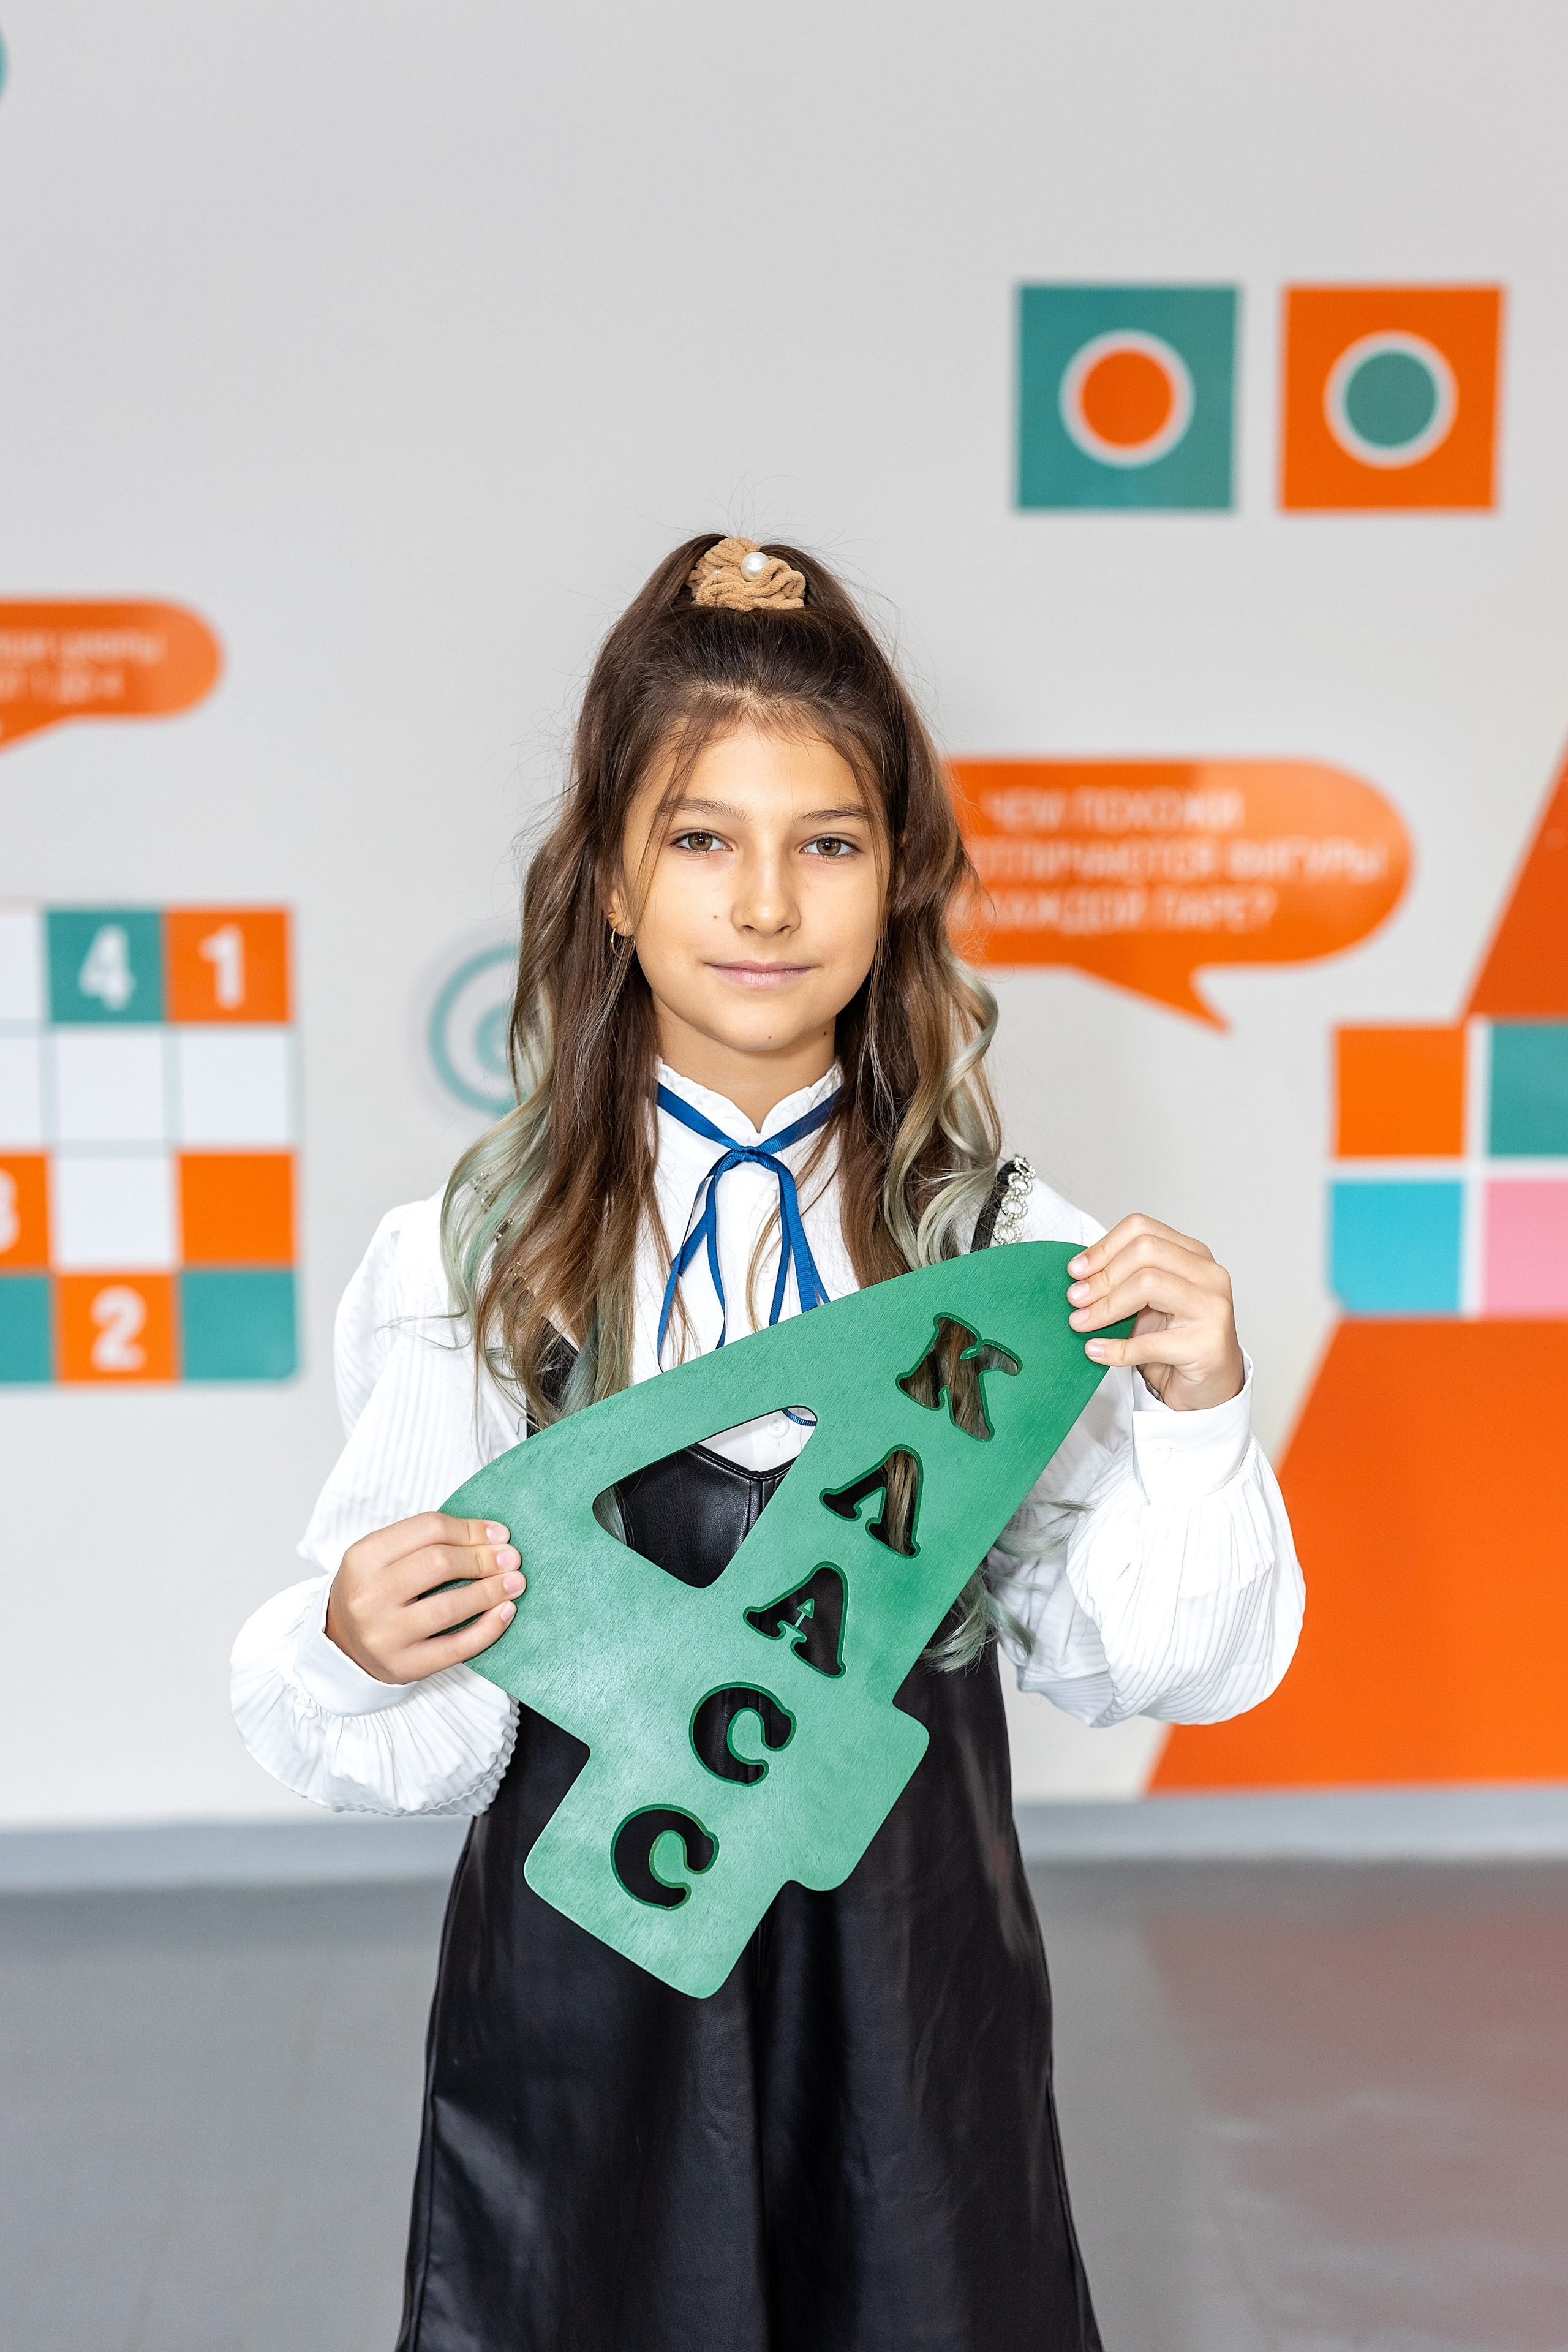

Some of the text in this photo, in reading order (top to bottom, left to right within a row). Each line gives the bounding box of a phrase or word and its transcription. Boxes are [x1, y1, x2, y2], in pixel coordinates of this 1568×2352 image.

[78, 924, 136, 1009] 4
[199, 924, 245, 1009] 1
[90, 1286, 146, 1372] 2
[611, 1311, 1022, 1911] КЛАСС
